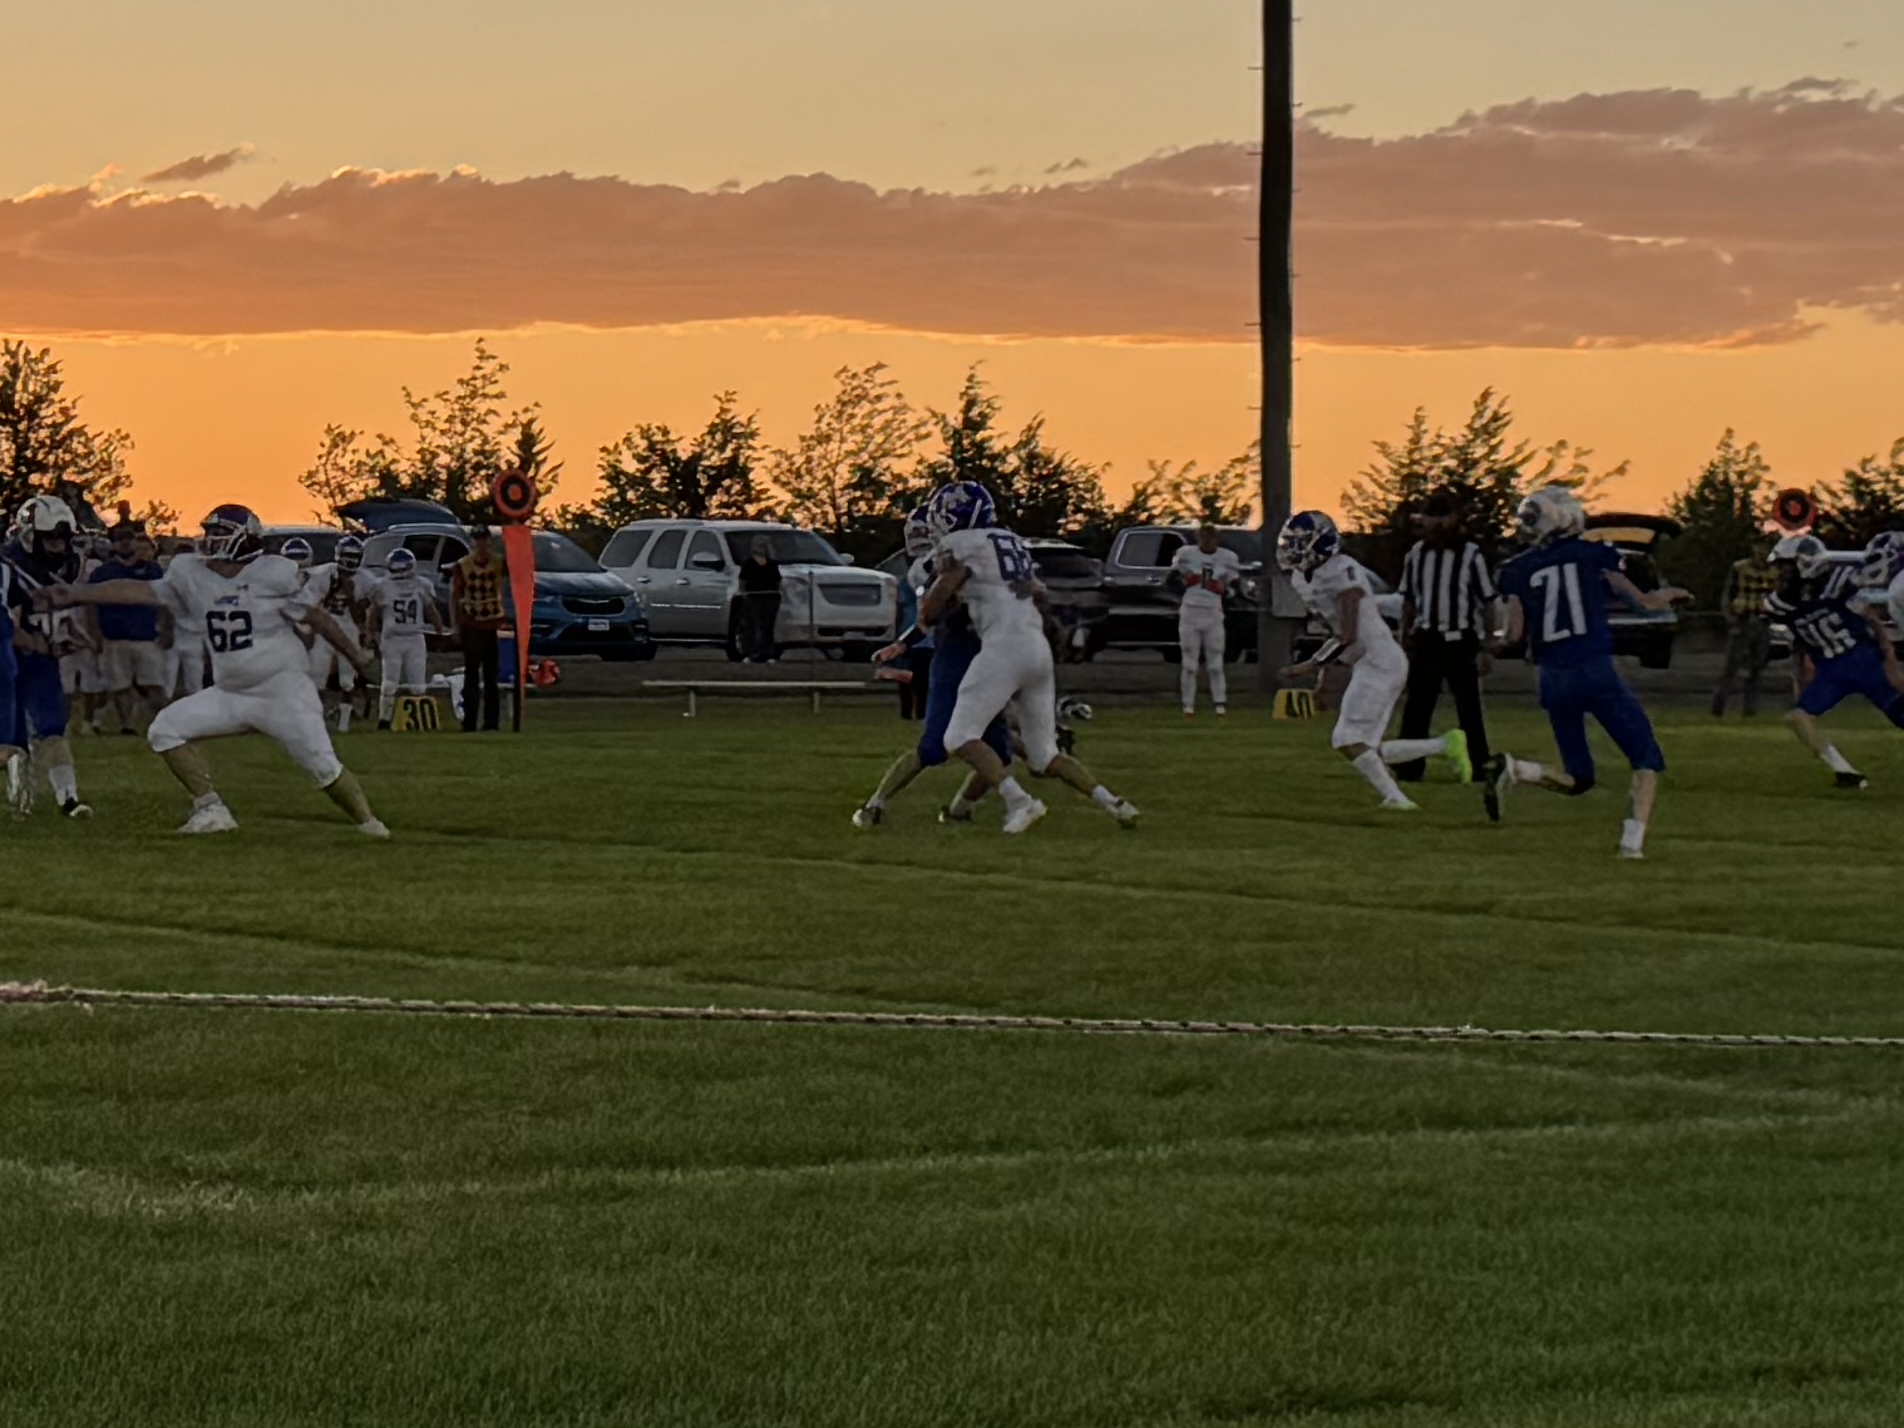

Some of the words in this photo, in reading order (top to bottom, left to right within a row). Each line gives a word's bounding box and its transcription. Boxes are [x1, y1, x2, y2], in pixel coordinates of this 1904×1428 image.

[1529, 562, 1587, 643] 21
[206, 610, 253, 653] 62
[402, 698, 438, 732] 30
